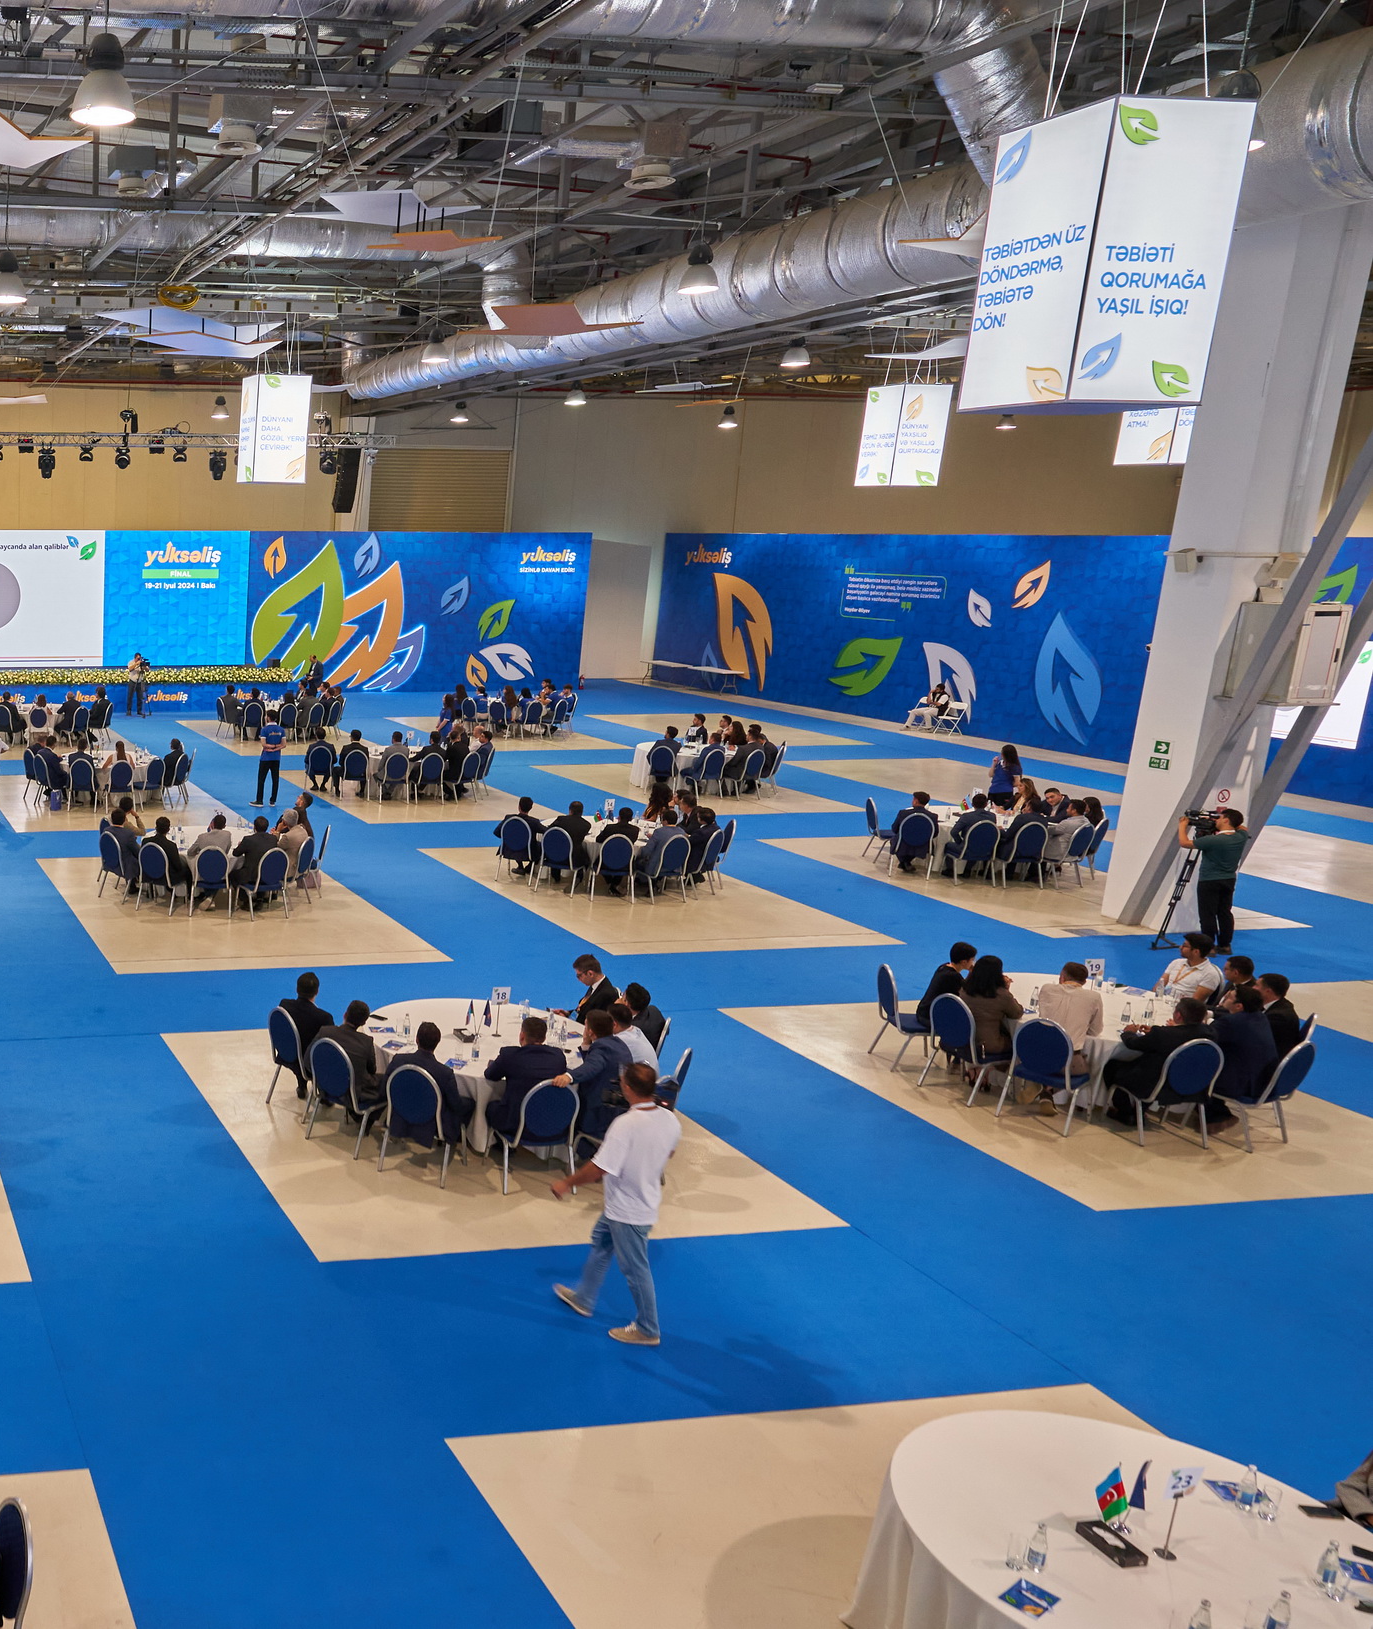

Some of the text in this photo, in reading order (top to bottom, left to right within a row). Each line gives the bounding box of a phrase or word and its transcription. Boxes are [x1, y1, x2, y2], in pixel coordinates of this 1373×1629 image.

[984, 224, 1087, 264] TƏBİƏTDƏN ÜZ
[1105, 243, 1175, 264] TƏBİƏTİ
[980, 255, 1064, 287] DÖNDƏRMƏ,
[1100, 269, 1207, 290] QORUMAĞA
[977, 285, 1034, 309] TƏBİƏTƏ
[1096, 296, 1189, 318] YAŞIL İŞIQ!
[973, 313, 1007, 333] DÖN!
[170, 570, 191, 578] FİNAL
[1089, 963, 1101, 972] 19
[495, 991, 507, 1000] 18
[1171, 1474, 1193, 1490] 23
